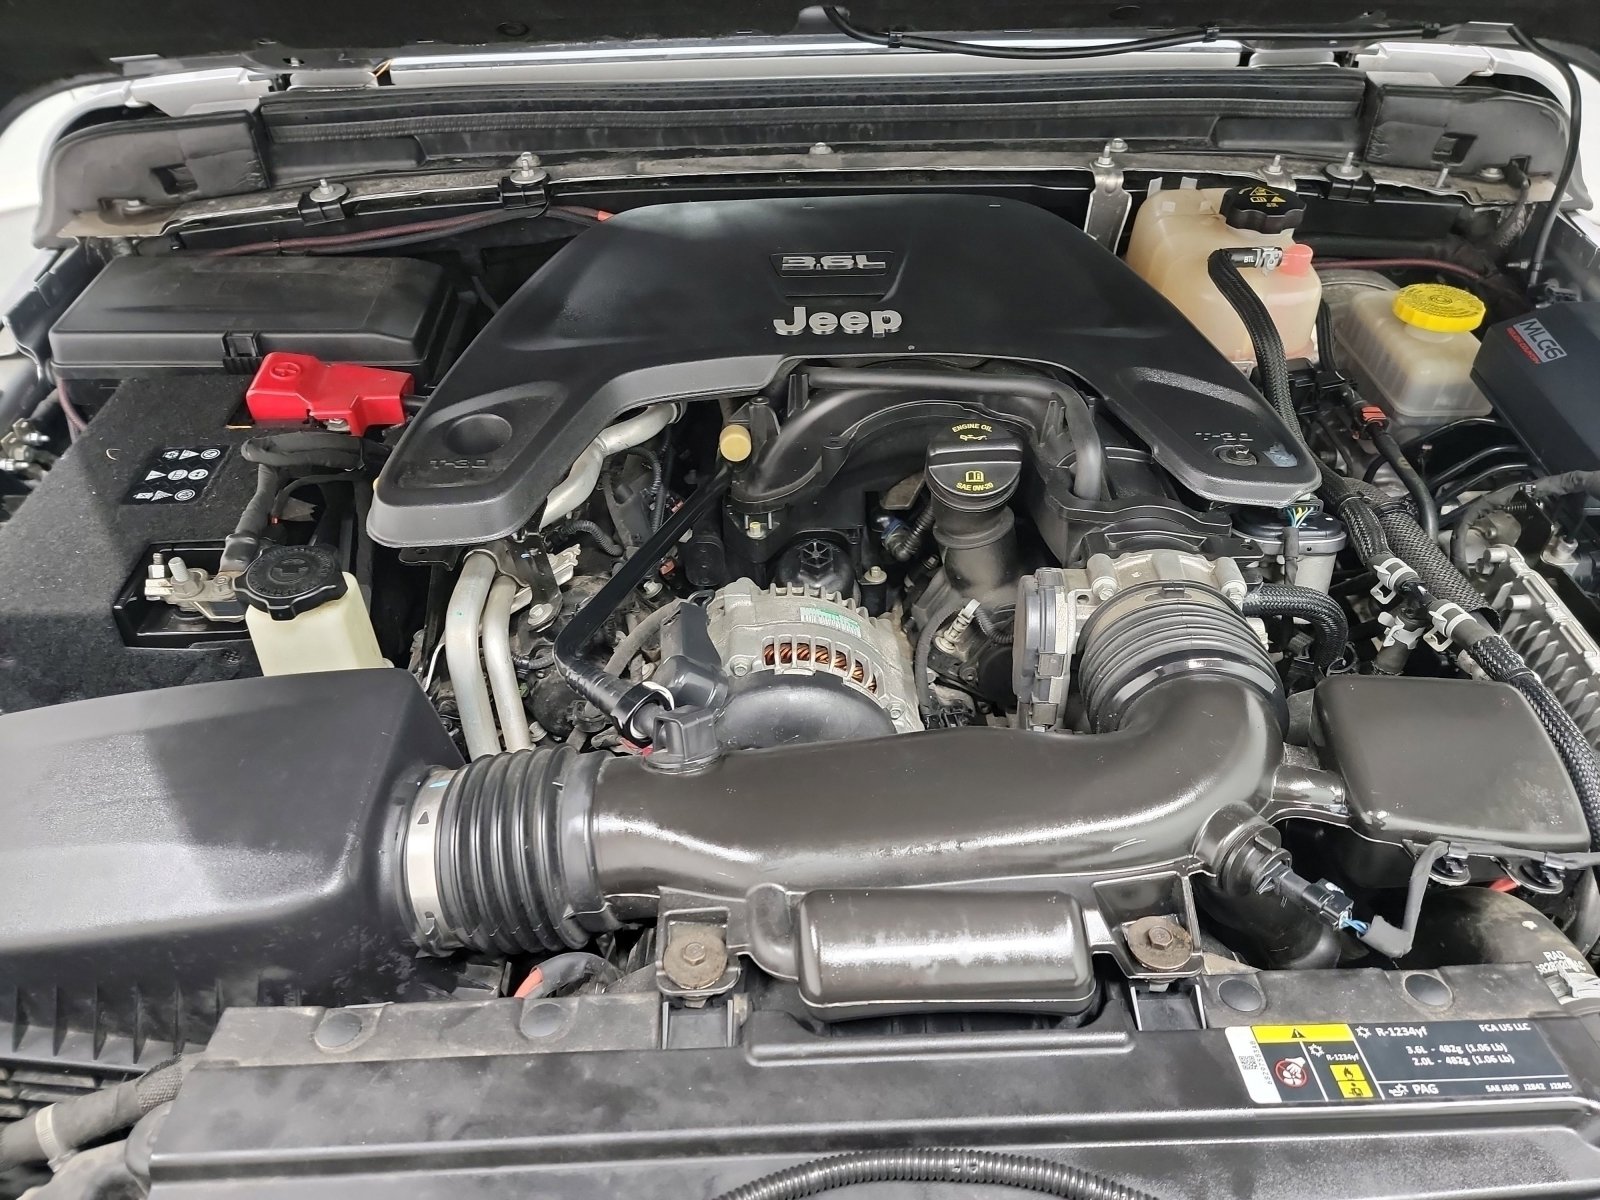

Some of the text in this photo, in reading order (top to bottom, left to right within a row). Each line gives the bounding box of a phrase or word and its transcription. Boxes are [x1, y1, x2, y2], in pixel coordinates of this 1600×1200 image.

[782, 255, 886, 270] 3.6L
[773, 306, 902, 338] Jeep
[952, 423, 993, 433] ENGINE OIL
[956, 482, 994, 491] SAE 0W-20
[1542, 950, 1566, 961] RAD
[1375, 1026, 1428, 1038] R-1234yf
[1479, 1024, 1499, 1032] FCA
[1513, 1023, 1531, 1031] LLC
[1406, 1045, 1428, 1054] 3.6L
[1439, 1045, 1464, 1055] 482g
[1465, 1043, 1491, 1054] (1.06
[1491, 1043, 1508, 1053] Lb)
[1325, 1053, 1360, 1062] R-1234yf
[1412, 1057, 1434, 1066] 2.0L
[1445, 1056, 1470, 1066] 482g
[1472, 1055, 1498, 1065] (1.06
[1498, 1054, 1515, 1064] Lb)
[1412, 1084, 1439, 1095] PAG
